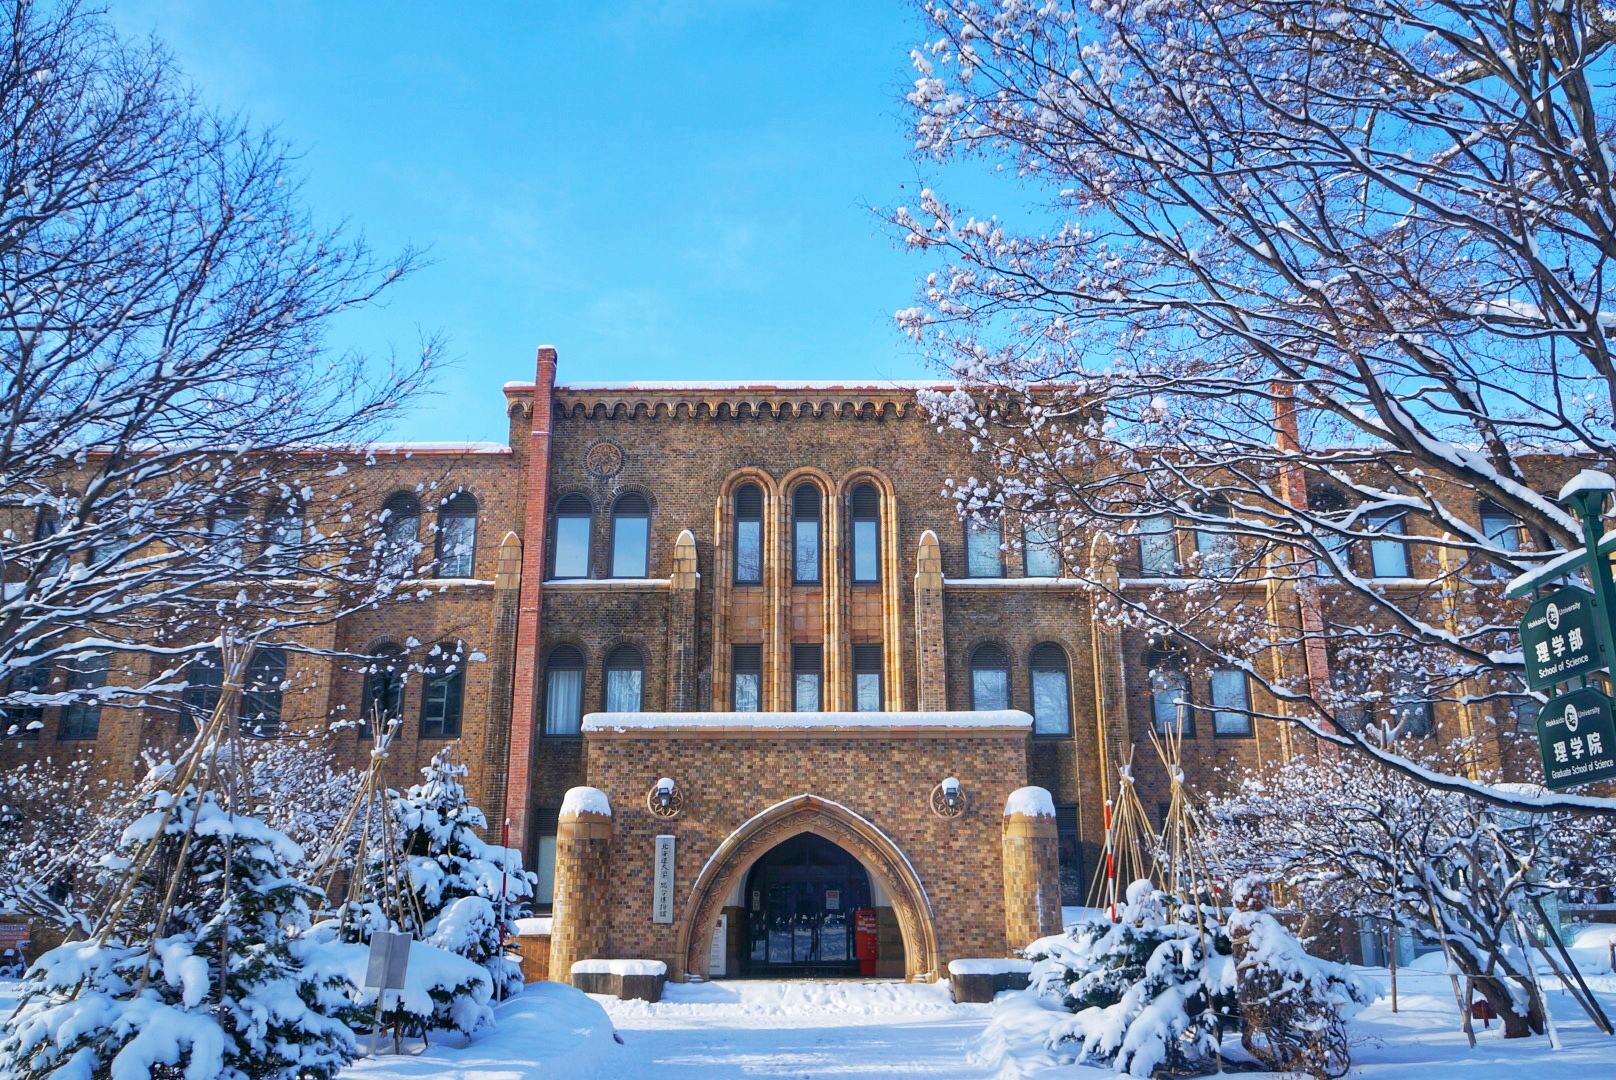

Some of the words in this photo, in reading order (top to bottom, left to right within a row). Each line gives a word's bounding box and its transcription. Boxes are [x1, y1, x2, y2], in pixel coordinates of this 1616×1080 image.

[1527, 616, 1547, 629] Hokkaido
[1559, 602, 1581, 615] University
[1535, 627, 1583, 663] 理学部
[1538, 664, 1557, 678] School
[1558, 661, 1565, 672] of
[1565, 655, 1589, 669] Science
[1545, 717, 1565, 728] Hokkaido
[1578, 706, 1600, 718] University
[1553, 732, 1603, 763] 理学院
[1551, 768, 1572, 779] Graduate
[1571, 764, 1588, 775] School
[1588, 762, 1594, 771] of
[1594, 759, 1614, 770] Science
